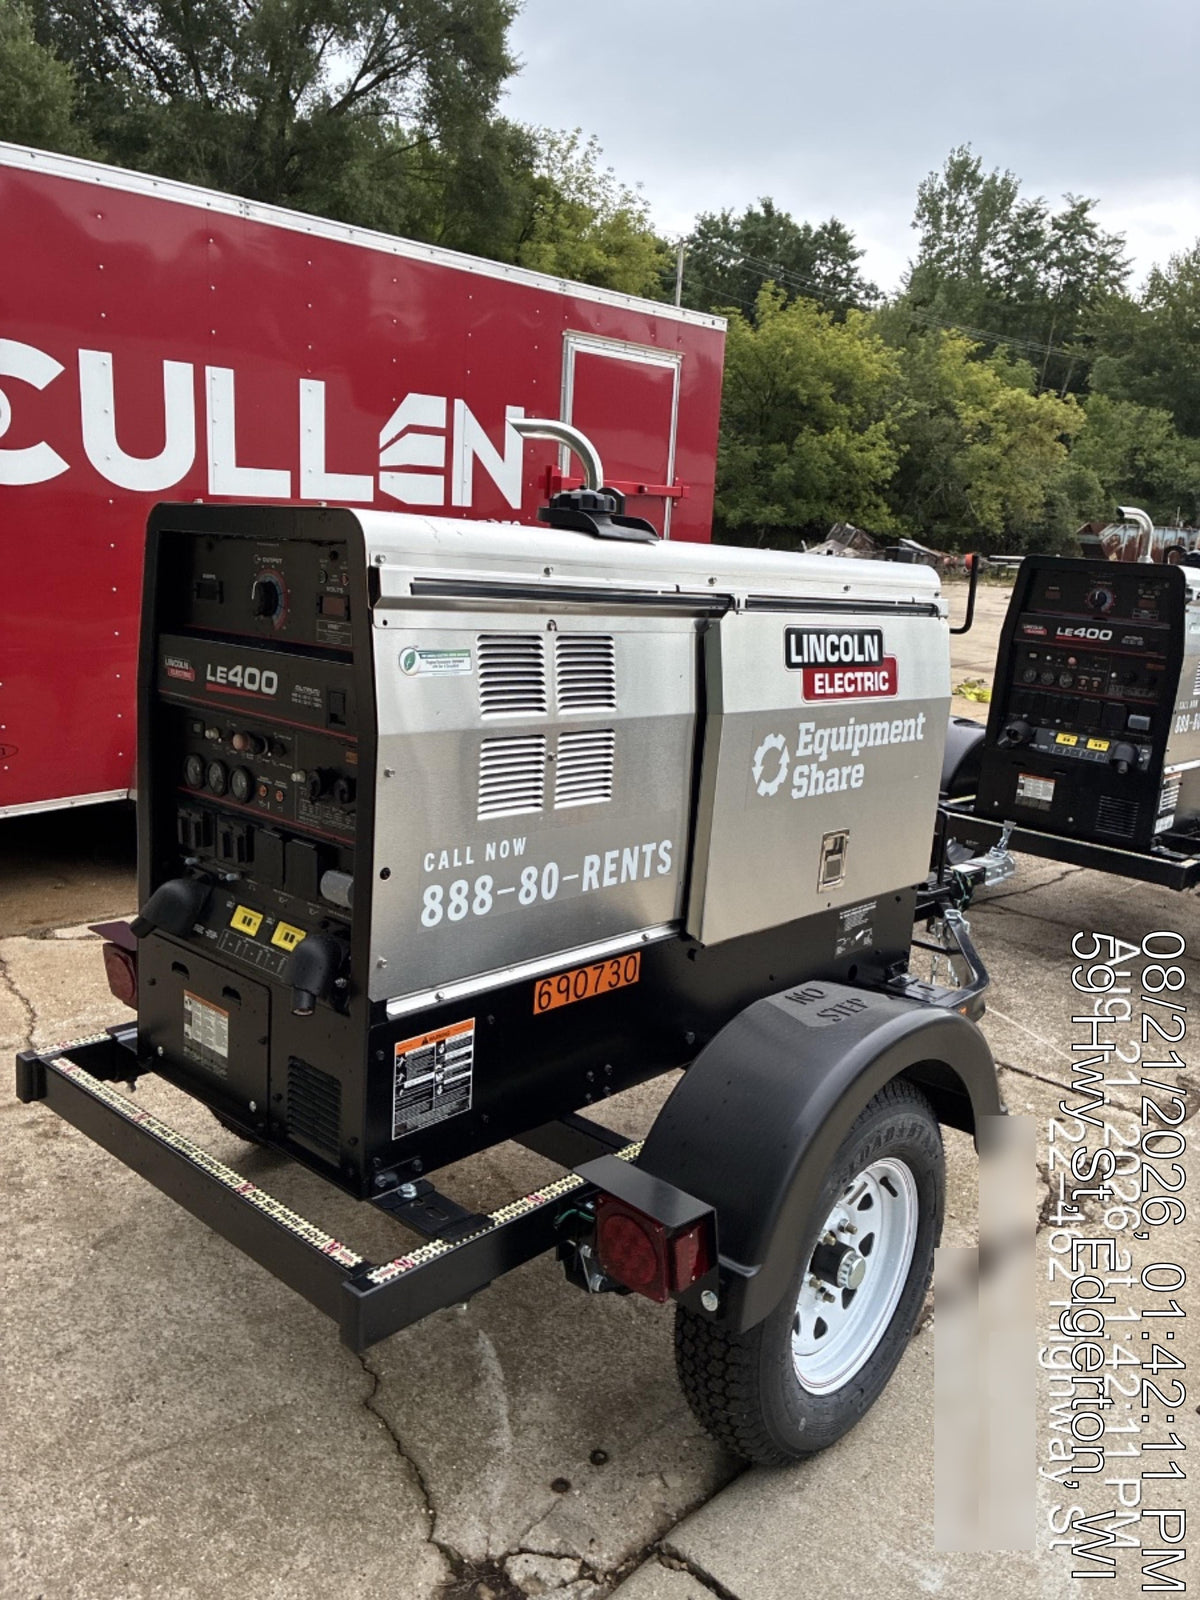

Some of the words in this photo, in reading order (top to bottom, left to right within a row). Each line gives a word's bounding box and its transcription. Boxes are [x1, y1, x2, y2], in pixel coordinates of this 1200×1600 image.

[790, 633, 879, 663] LINCOLN
[1056, 626, 1113, 641] LE400
[164, 657, 190, 670] LINCOLN
[206, 664, 278, 696] LE400
[814, 670, 889, 694] ELECTRIC
[796, 711, 926, 760] Equipment
[791, 763, 864, 800] Share
[423, 845, 474, 873] CALL
[485, 836, 527, 862] NOW
[420, 840, 673, 928] 888-80-RENTS
[536, 954, 638, 1012] 690730
[784, 988, 826, 1006] NO
[816, 998, 869, 1022] STEP
[249, 1188, 266, 1203] NO
[263, 1198, 278, 1211] SE
[276, 1207, 304, 1229] PARE
